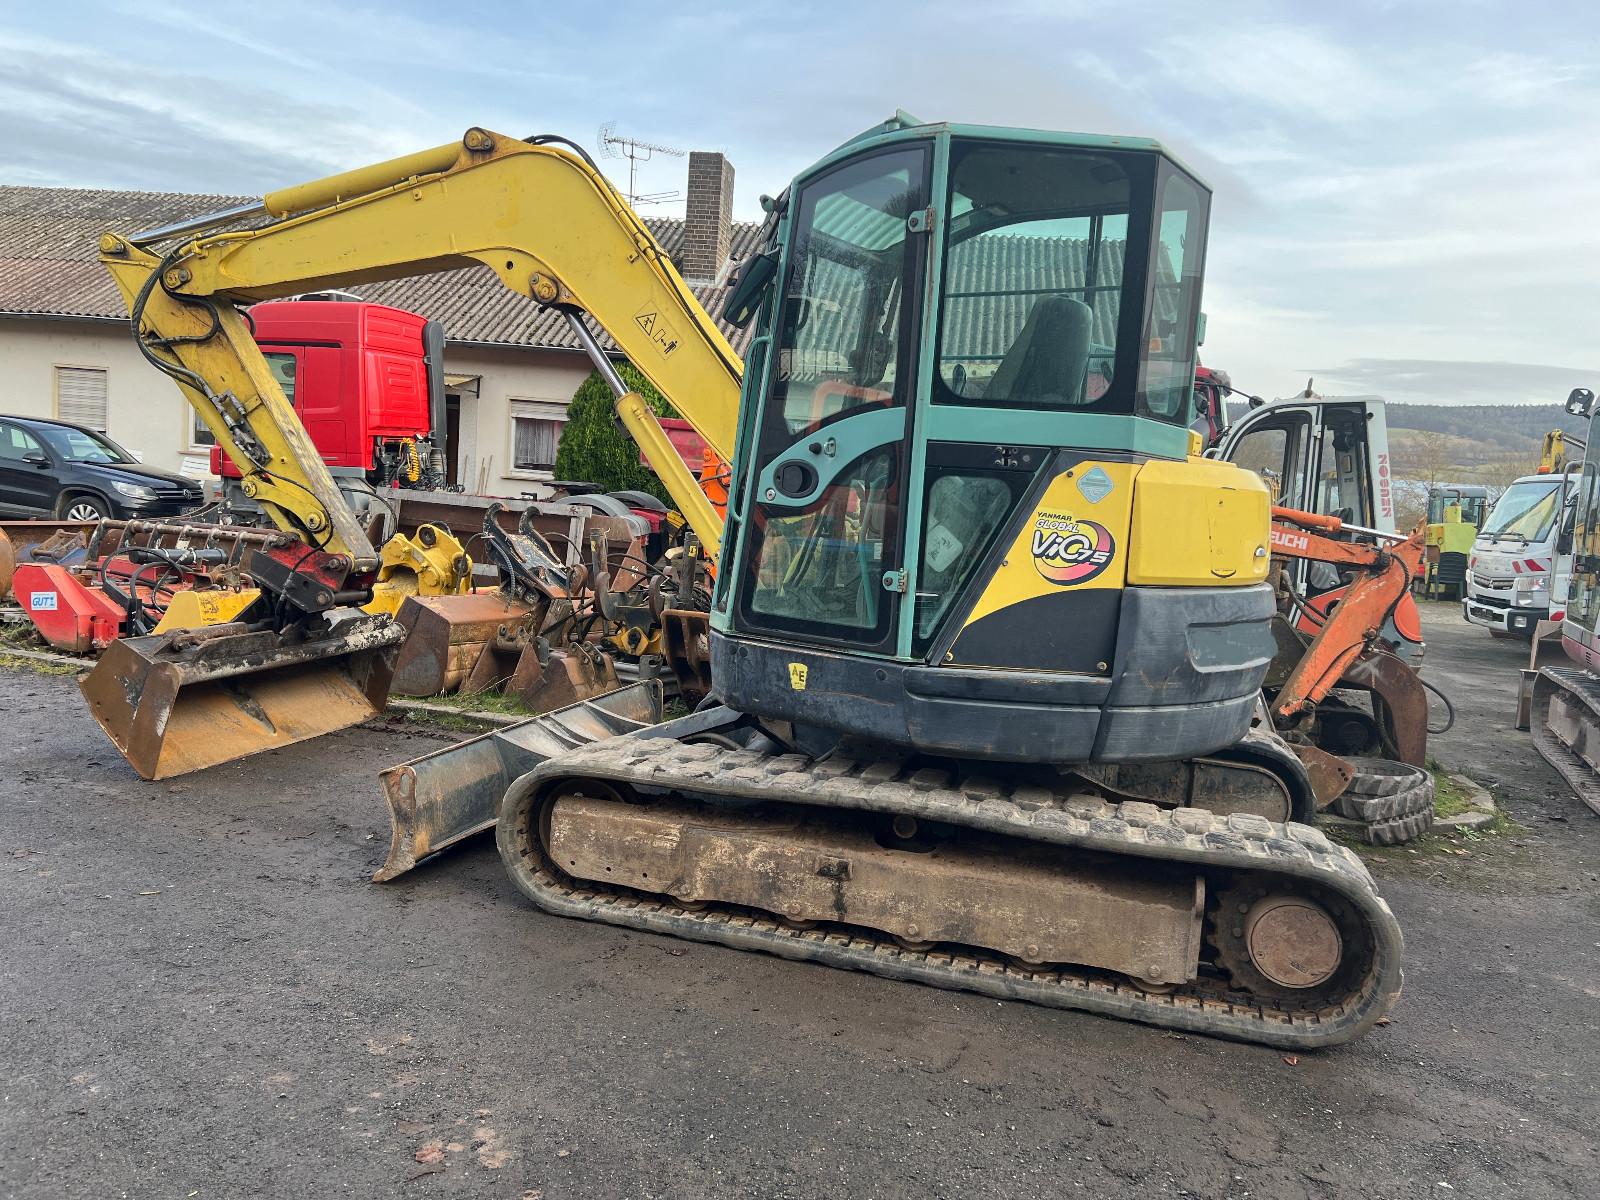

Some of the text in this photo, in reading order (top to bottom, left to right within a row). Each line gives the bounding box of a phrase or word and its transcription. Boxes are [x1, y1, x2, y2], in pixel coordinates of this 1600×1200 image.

[1378, 454, 1392, 518] NEUSON
[1038, 512, 1072, 521] YANMAR
[1035, 519, 1080, 533] GLOBAL
[1271, 531, 1309, 550] EUCHI
